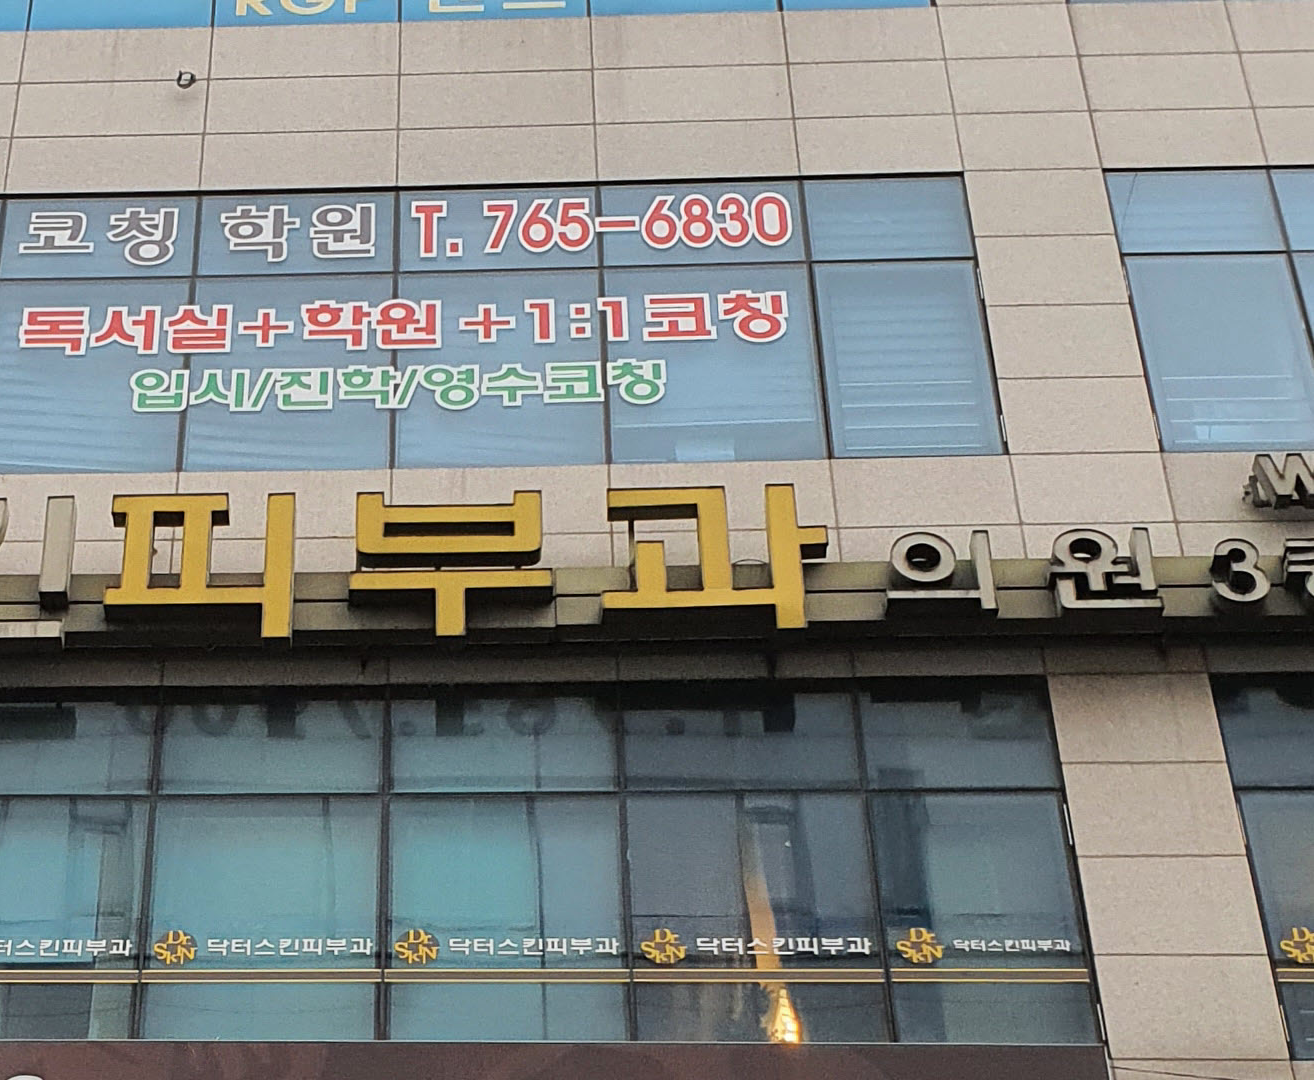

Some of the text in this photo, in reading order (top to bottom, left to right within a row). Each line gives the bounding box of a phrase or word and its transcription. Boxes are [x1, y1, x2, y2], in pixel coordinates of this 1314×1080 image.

[411, 200, 463, 258] T.
[483, 191, 793, 254] 765-6830
[207, 937, 374, 956] 닥터스킨피부과
[449, 936, 620, 956] 닥터스킨피부과
[696, 936, 872, 956] 닥터스킨피부과
[952, 938, 1072, 952] 닥터스킨피부과
